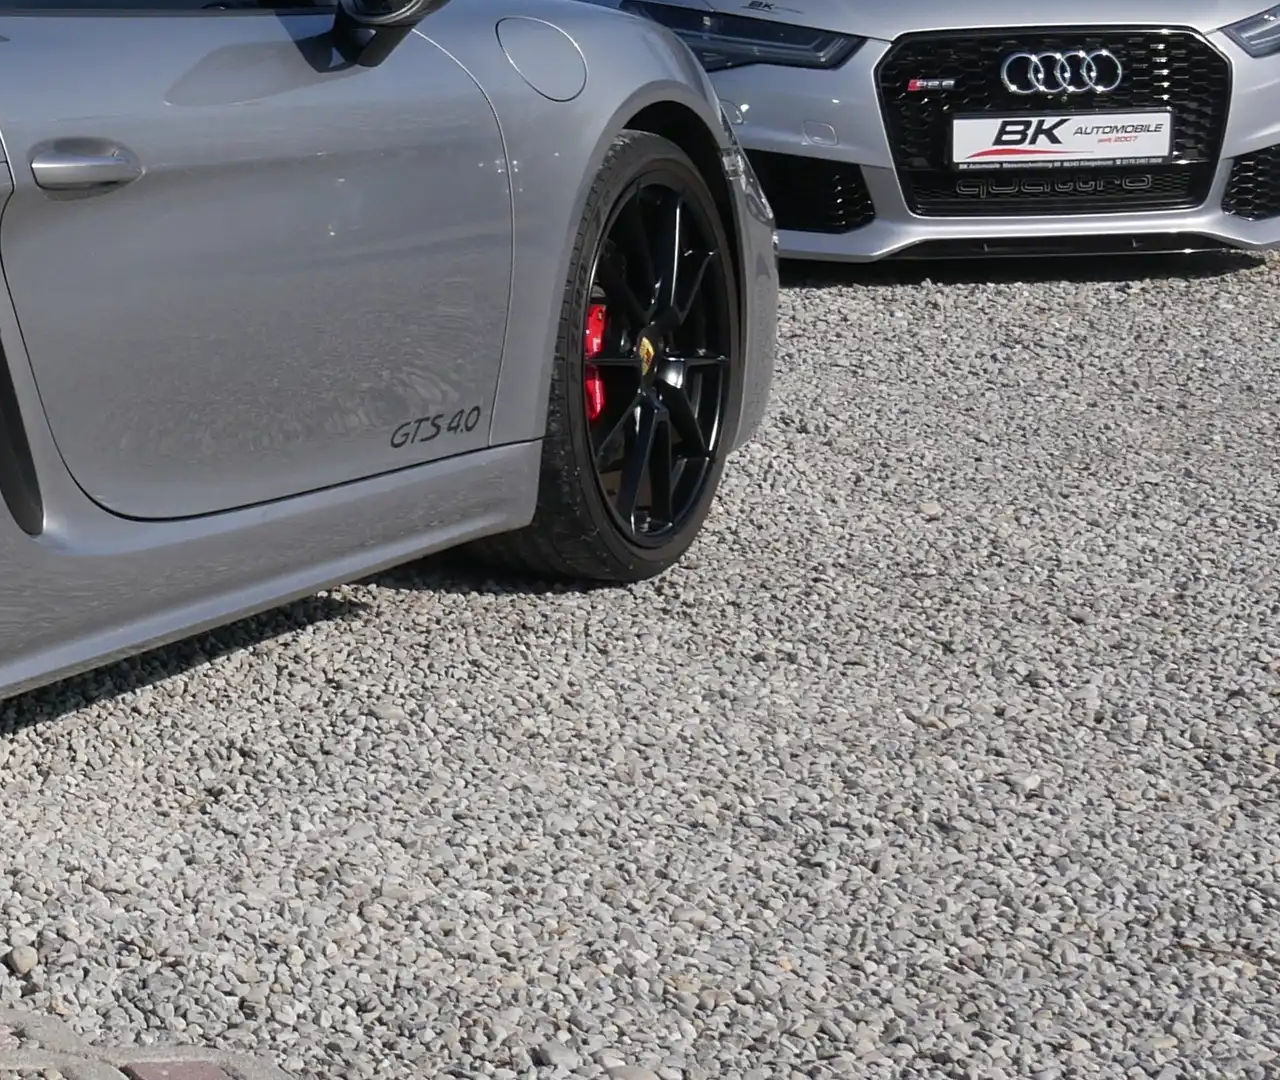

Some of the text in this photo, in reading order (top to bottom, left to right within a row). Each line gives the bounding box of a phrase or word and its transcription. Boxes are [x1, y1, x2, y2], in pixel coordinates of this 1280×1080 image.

[993, 118, 1164, 147] BK AUTOMOBILE
[956, 173, 1153, 199] quattro
[390, 405, 481, 449] GTS 4.0
